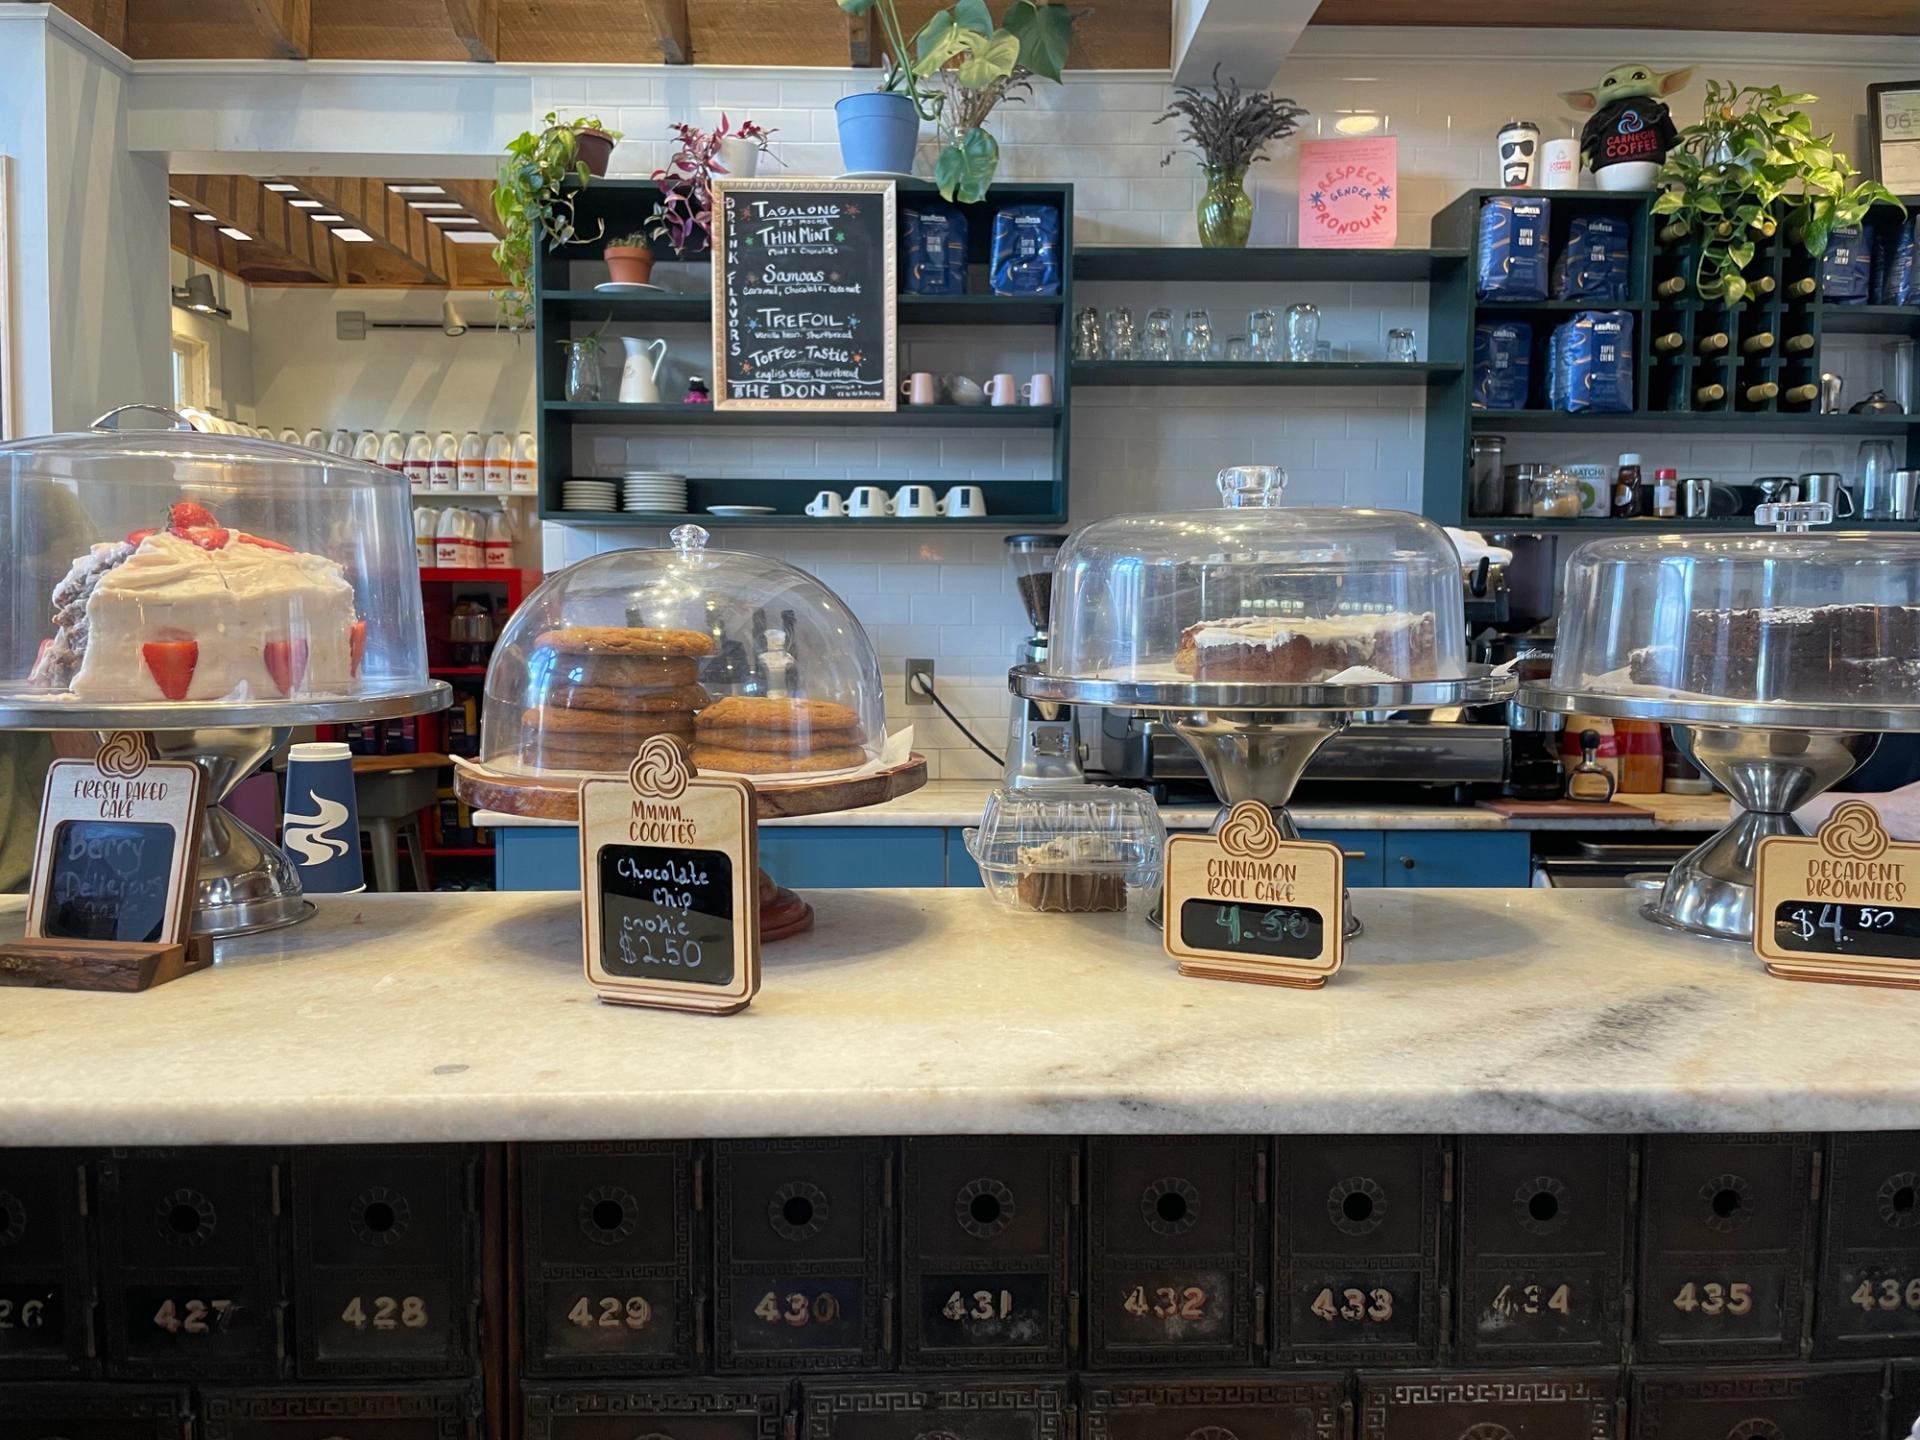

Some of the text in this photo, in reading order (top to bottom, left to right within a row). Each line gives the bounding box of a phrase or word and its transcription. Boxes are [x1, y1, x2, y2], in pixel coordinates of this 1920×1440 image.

[1606, 139, 1658, 157] COFFEE
[1318, 165, 1385, 193] RESPECT
[1330, 186, 1373, 202] GENDER
[751, 201, 841, 218] TAGALONG
[1311, 200, 1388, 235] PRONOUNS
[756, 226, 796, 246] THIN
[762, 263, 825, 283] Samoas
[756, 307, 844, 328] TREFOIL
[733, 384, 770, 398] THE
[780, 384, 826, 398] DON
[74, 780, 168, 801] FRESH BAKED
[100, 799, 134, 819] CAKE
[629, 822, 696, 845] COOKIES
[617, 858, 709, 885] Chocolate
[1207, 858, 1297, 881] CINNAMON
[1808, 859, 1904, 882] DECADENT
[1207, 878, 1296, 903] ROLL CAKE
[1806, 878, 1906, 902] BROWNIES
[619, 931, 702, 968] $2.50
[754, 1291, 840, 1328] 430
[942, 1289, 1014, 1323] 431
[1123, 1285, 1207, 1322] 432
[1310, 1287, 1394, 1323] 433
[1490, 1283, 1571, 1317] 434
[1672, 1281, 1753, 1316] 435
[153, 1297, 234, 1334] 427
[341, 1295, 429, 1331] 428
[567, 1295, 653, 1330] 429
